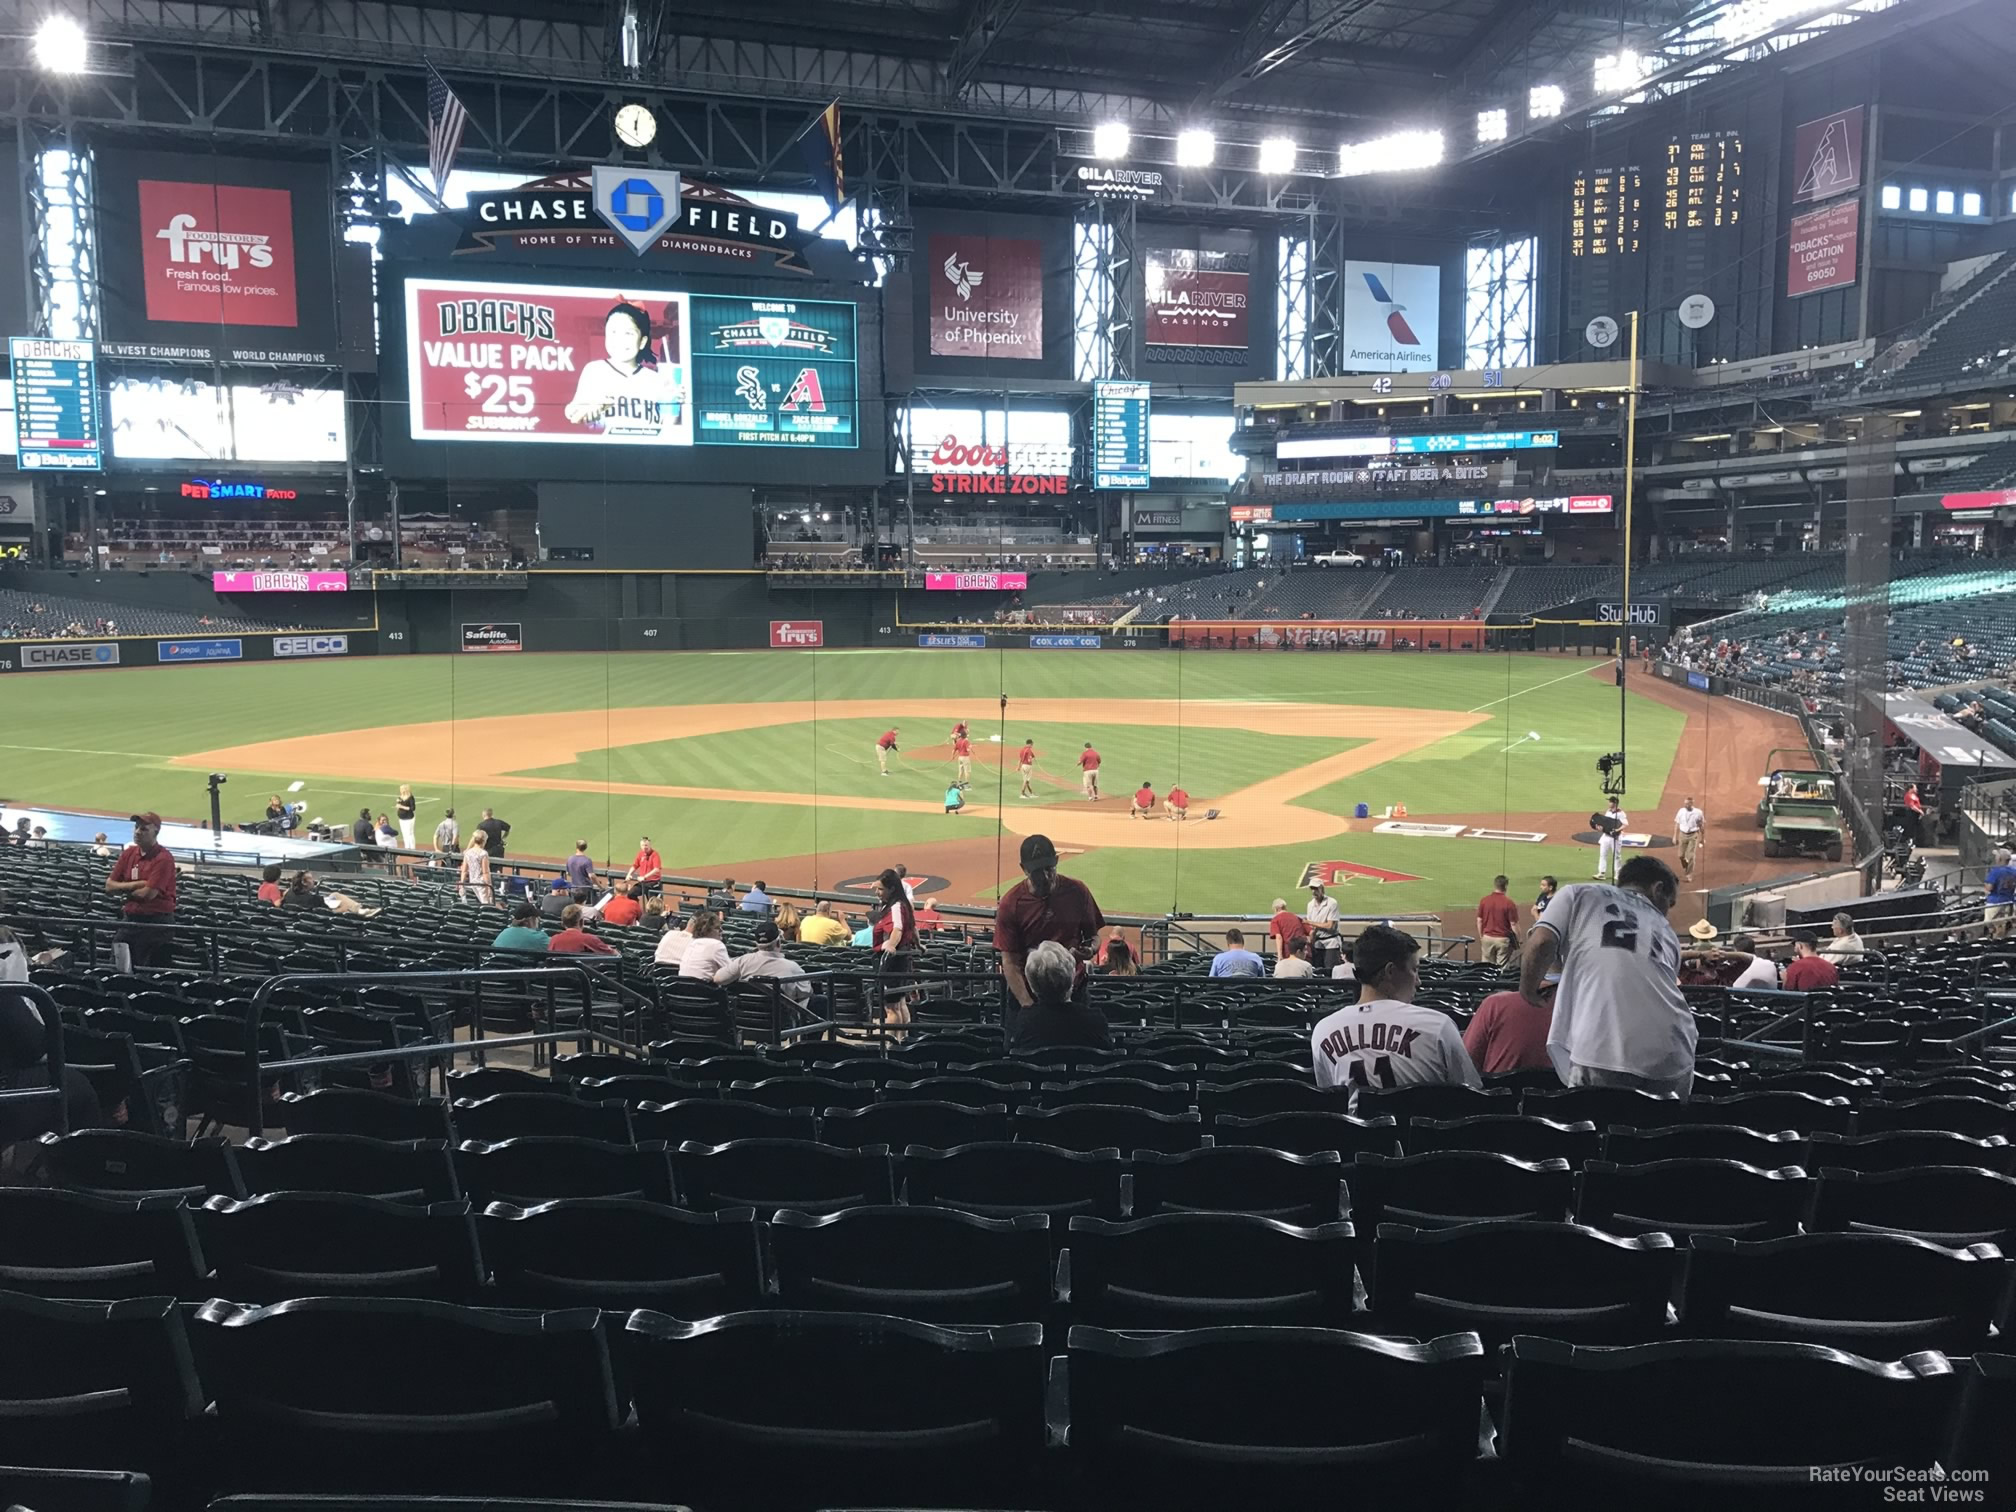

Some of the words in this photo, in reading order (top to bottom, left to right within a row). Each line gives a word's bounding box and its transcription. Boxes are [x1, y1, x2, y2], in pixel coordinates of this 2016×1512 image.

[1668, 145, 1680, 154] 37
[1667, 167, 1679, 176] 43
[1690, 166, 1705, 174] CLE
[1574, 179, 1585, 187] 44
[1667, 177, 1679, 185] 53
[1094, 191, 1147, 201] CASINOS
[1574, 188, 1585, 196] 63
[1666, 190, 1678, 198] 45
[1689, 188, 1703, 196] PIT
[1573, 199, 1584, 208] 51
[1666, 199, 1677, 208] 26
[480, 200, 586, 222] CHASE
[689, 207, 787, 240] FIELD
[1665, 212, 1677, 220] 50
[1665, 221, 1676, 229] 41
[186, 232, 217, 241] FOOD
[221, 233, 264, 243] STORES
[1573, 228, 1584, 236] 23
[156, 213, 273, 270] fry's
[520, 233, 556, 245] HOME
[566, 235, 581, 244] OF
[591, 235, 615, 245] THE
[661, 240, 752, 258] DIAMONDBACKS
[1573, 240, 1584, 248] 32
[1573, 248, 1584, 256] 41
[1801, 244, 1844, 263] LOCATION
[166, 268, 199, 280] Fresh
[202, 270, 232, 281] food.
[1807, 267, 1835, 281] 69050
[177, 281, 221, 293] Famous
[223, 283, 241, 294] low
[244, 285, 278, 296] prices.
[752, 302, 786, 313] WELCOME
[787, 304, 796, 313] TO
[945, 306, 1019, 328] University
[1162, 317, 1229, 327] CASINOS
[723, 328, 759, 338] CHASE
[791, 330, 826, 342] FIELD
[945, 327, 961, 342] of
[964, 328, 1022, 345] Phoenix
[101, 345, 115, 355] NL
[117, 346, 147, 355] WEST
[150, 347, 211, 358] CHAMPIONS
[233, 350, 266, 360] WORLD
[268, 352, 326, 363] CHAMPIONS
[423, 341, 503, 369] VALUE
[510, 344, 575, 372] PACK
[1350, 349, 1396, 361] American
[1396, 351, 1432, 363] Airlines
[1371, 377, 1392, 393] 42
[1428, 374, 1451, 391] 20
[1483, 371, 1503, 387] 51
[464, 371, 536, 414] $25
[738, 432, 758, 441] FIRST
[759, 432, 780, 442] PITCH
[781, 433, 789, 442] AT
[931, 434, 1008, 466] Coors
[41, 452, 97, 468] Ballpark
[1263, 474, 1283, 486] THE
[1285, 472, 1318, 485] DRAFT
[1322, 471, 1354, 484] ROOM
[1410, 468, 1439, 481] BEER
[1455, 466, 1489, 480] BITES
[931, 474, 1006, 493] STRIKE
[1010, 475, 1068, 494] ZONE
[1111, 474, 1147, 487] Ballpark
[266, 489, 296, 500] PATIO
[1153, 516, 1180, 524] FITNESS
[1600, 605, 1656, 623] StuHub
[388, 631, 403, 640] 413
[465, 631, 507, 639] Safelite
[643, 629, 658, 638] 407
[776, 623, 817, 644] fry's
[277, 638, 344, 654] GEICO
[1036, 638, 1053, 646] COX
[1058, 638, 1075, 646] COX
[1080, 638, 1097, 646] COX
[1123, 639, 1136, 647] 376
[30, 648, 92, 663] CHASE
[180, 646, 200, 655] pepsi
[1320, 1023, 1421, 1066] POLLOCK
[1348, 1055, 1398, 1089] 11
